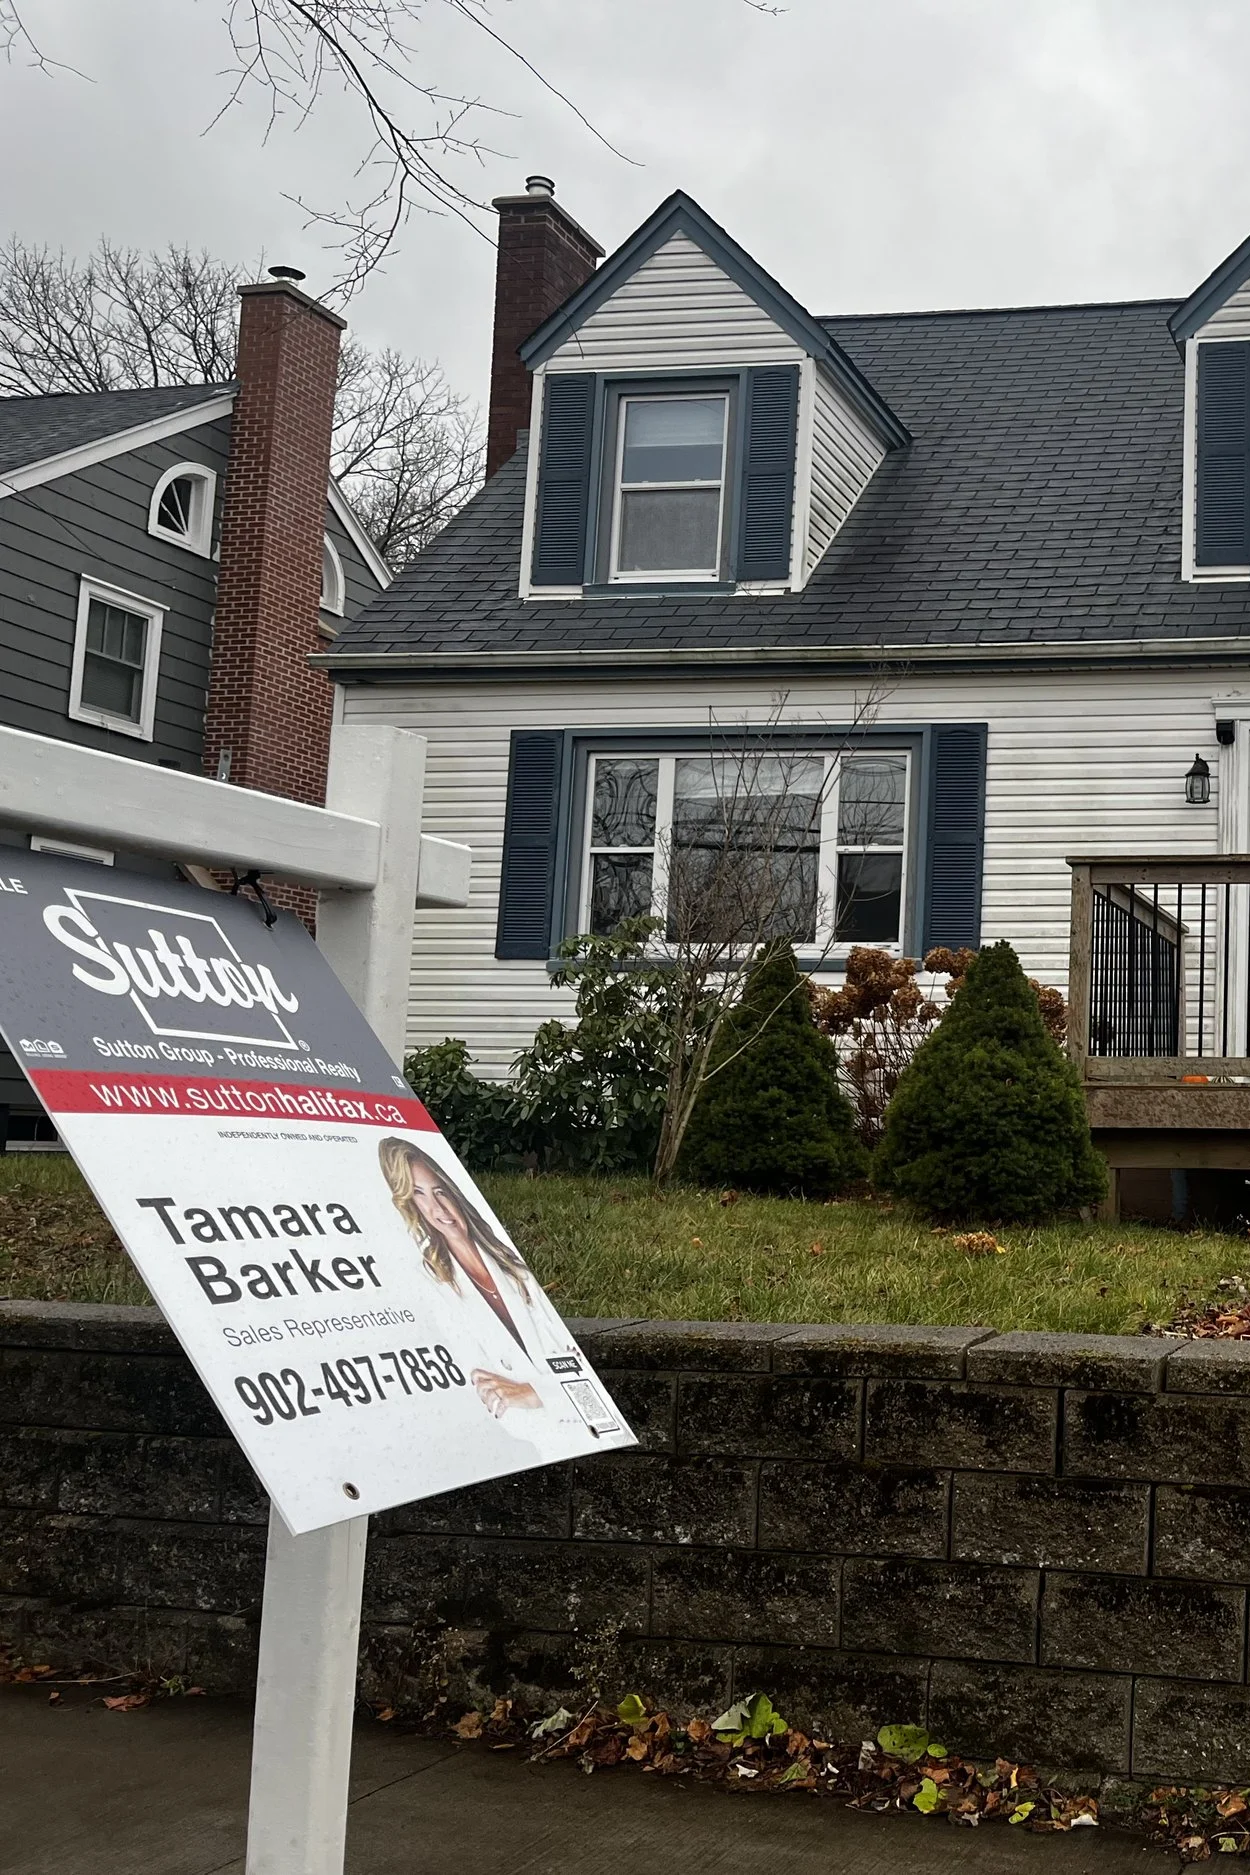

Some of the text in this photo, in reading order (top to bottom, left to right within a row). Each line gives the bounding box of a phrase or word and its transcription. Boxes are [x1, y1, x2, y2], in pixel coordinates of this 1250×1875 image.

[0, 877, 29, 895] LE
[43, 905, 299, 1014] Sutton
[92, 1036, 159, 1059] Sutton
[158, 1041, 215, 1067] Group
[224, 1047, 319, 1074] Professional
[315, 1058, 361, 1083] Realty
[89, 1084, 407, 1124] www.suttonhalifax.ca
[217, 1131, 359, 1143] INDEPENDENTLY OWNED AND OPERATED
[135, 1197, 363, 1245] Tamara
[184, 1249, 382, 1305] Barker
[222, 1307, 416, 1347] Sales Representative
[234, 1344, 467, 1426] 902-497-7858
